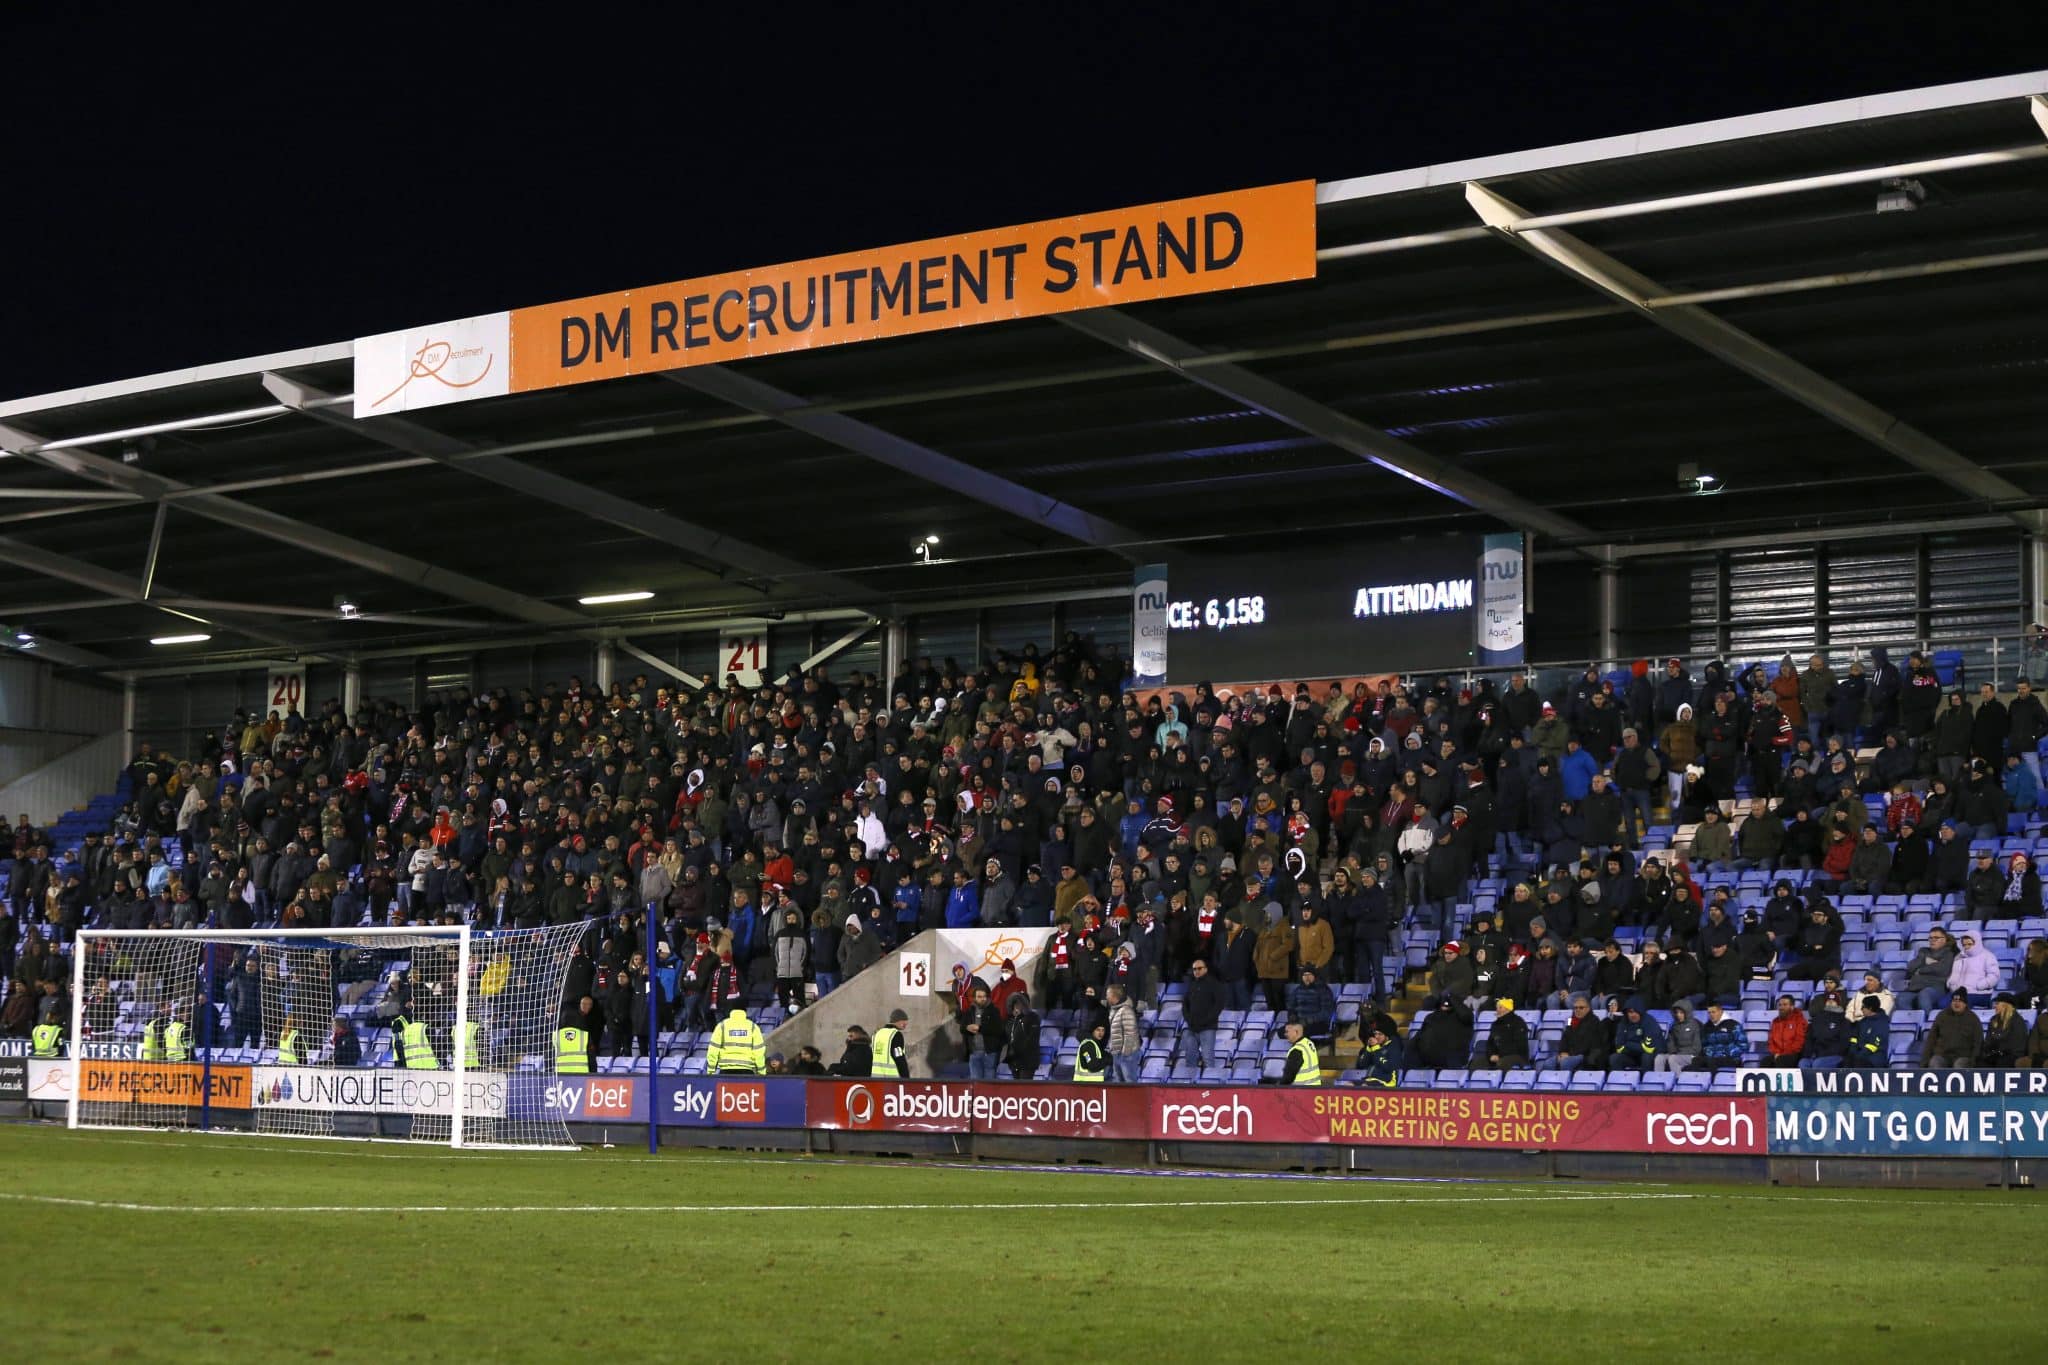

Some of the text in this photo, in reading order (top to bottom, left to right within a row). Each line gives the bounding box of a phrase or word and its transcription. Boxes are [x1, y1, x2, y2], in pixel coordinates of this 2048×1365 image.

[561, 211, 1244, 368] DM RECRUITMENT STAND
[1166, 596, 1264, 632] CE: 6,158
[727, 636, 759, 672] 21
[272, 675, 301, 706] 20
[903, 962, 927, 987] 13
[88, 1070, 114, 1092] DM
[119, 1071, 243, 1098] RECRUITMENT
[297, 1075, 394, 1106] UNIQUE
[544, 1081, 628, 1114] sky bet
[673, 1083, 760, 1119] sky bet
[883, 1085, 1107, 1129] absolutepersonnel
[1314, 1095, 1580, 1121] SHROPSHIRE'S LEADING
[1331, 1118, 1562, 1143] MARKETING AGENCY
[1775, 1110, 2048, 1142] MONTGOMERY
